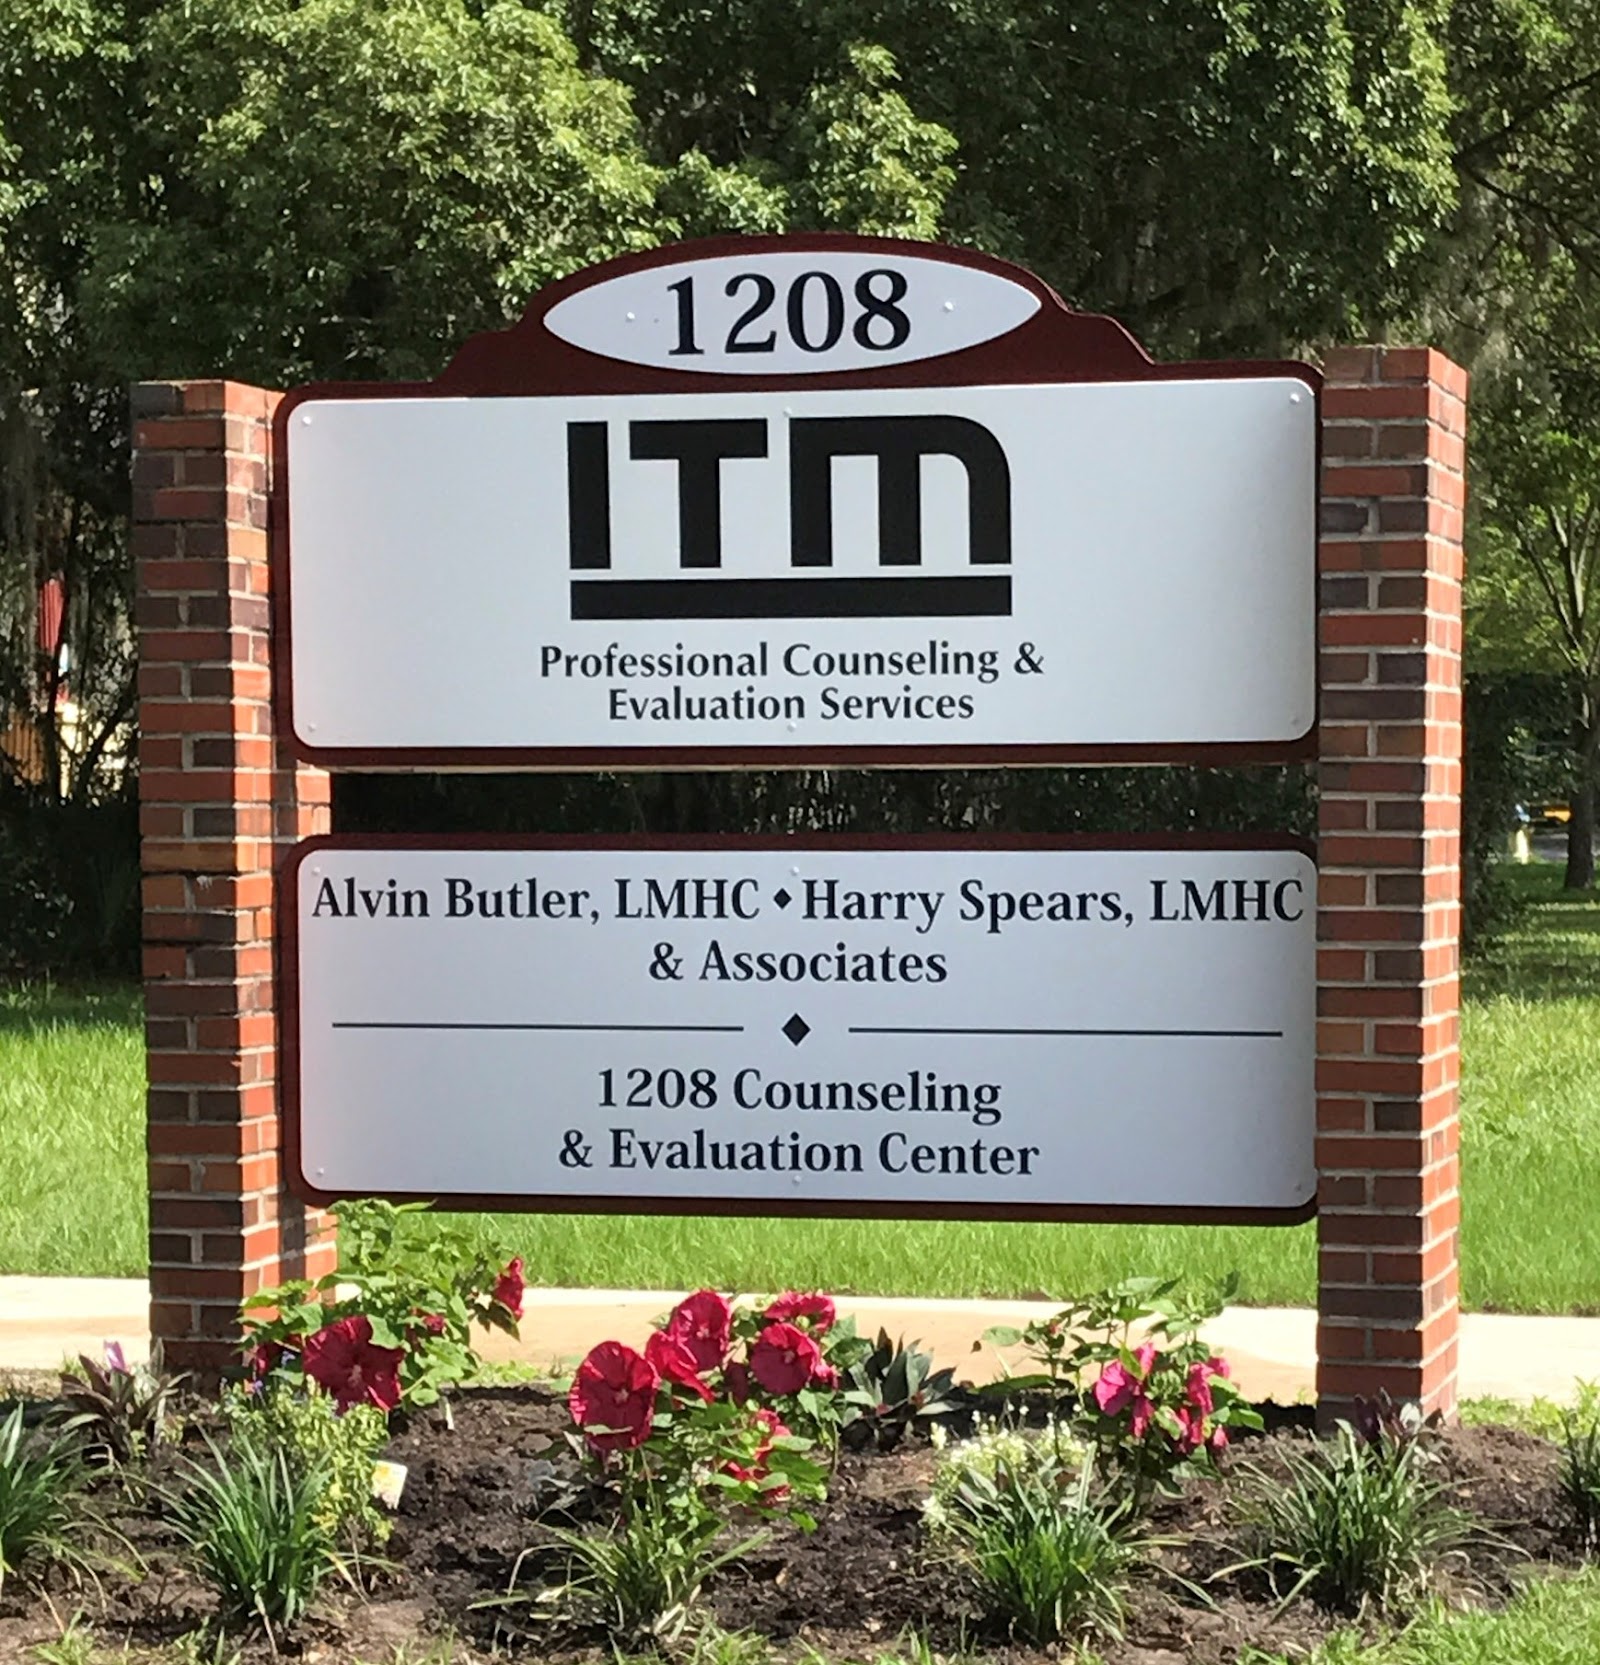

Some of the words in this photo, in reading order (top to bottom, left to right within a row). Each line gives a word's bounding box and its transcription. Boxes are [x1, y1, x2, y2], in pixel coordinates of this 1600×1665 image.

[666, 269, 911, 356] 1208
[566, 414, 1012, 570] ITM
[541, 641, 767, 678] Professional
[783, 640, 999, 684] Counseling
[1014, 642, 1044, 674] &
[609, 685, 805, 720] Evaluation
[820, 684, 974, 720] Services
[312, 876, 431, 918] Alvin
[444, 877, 599, 925] Butler,
[614, 878, 760, 920] LMHC
[802, 879, 945, 934] Harry
[959, 879, 1134, 934] Spears,
[1149, 879, 1304, 922] LMHC
[648, 942, 684, 981] &
[699, 939, 948, 983] Associates
[598, 1068, 718, 1109] 1208
[733, 1068, 1002, 1126] Counseling
[558, 1129, 594, 1168] &
[608, 1128, 864, 1173] Evaluation
[878, 1131, 1040, 1176] Center
